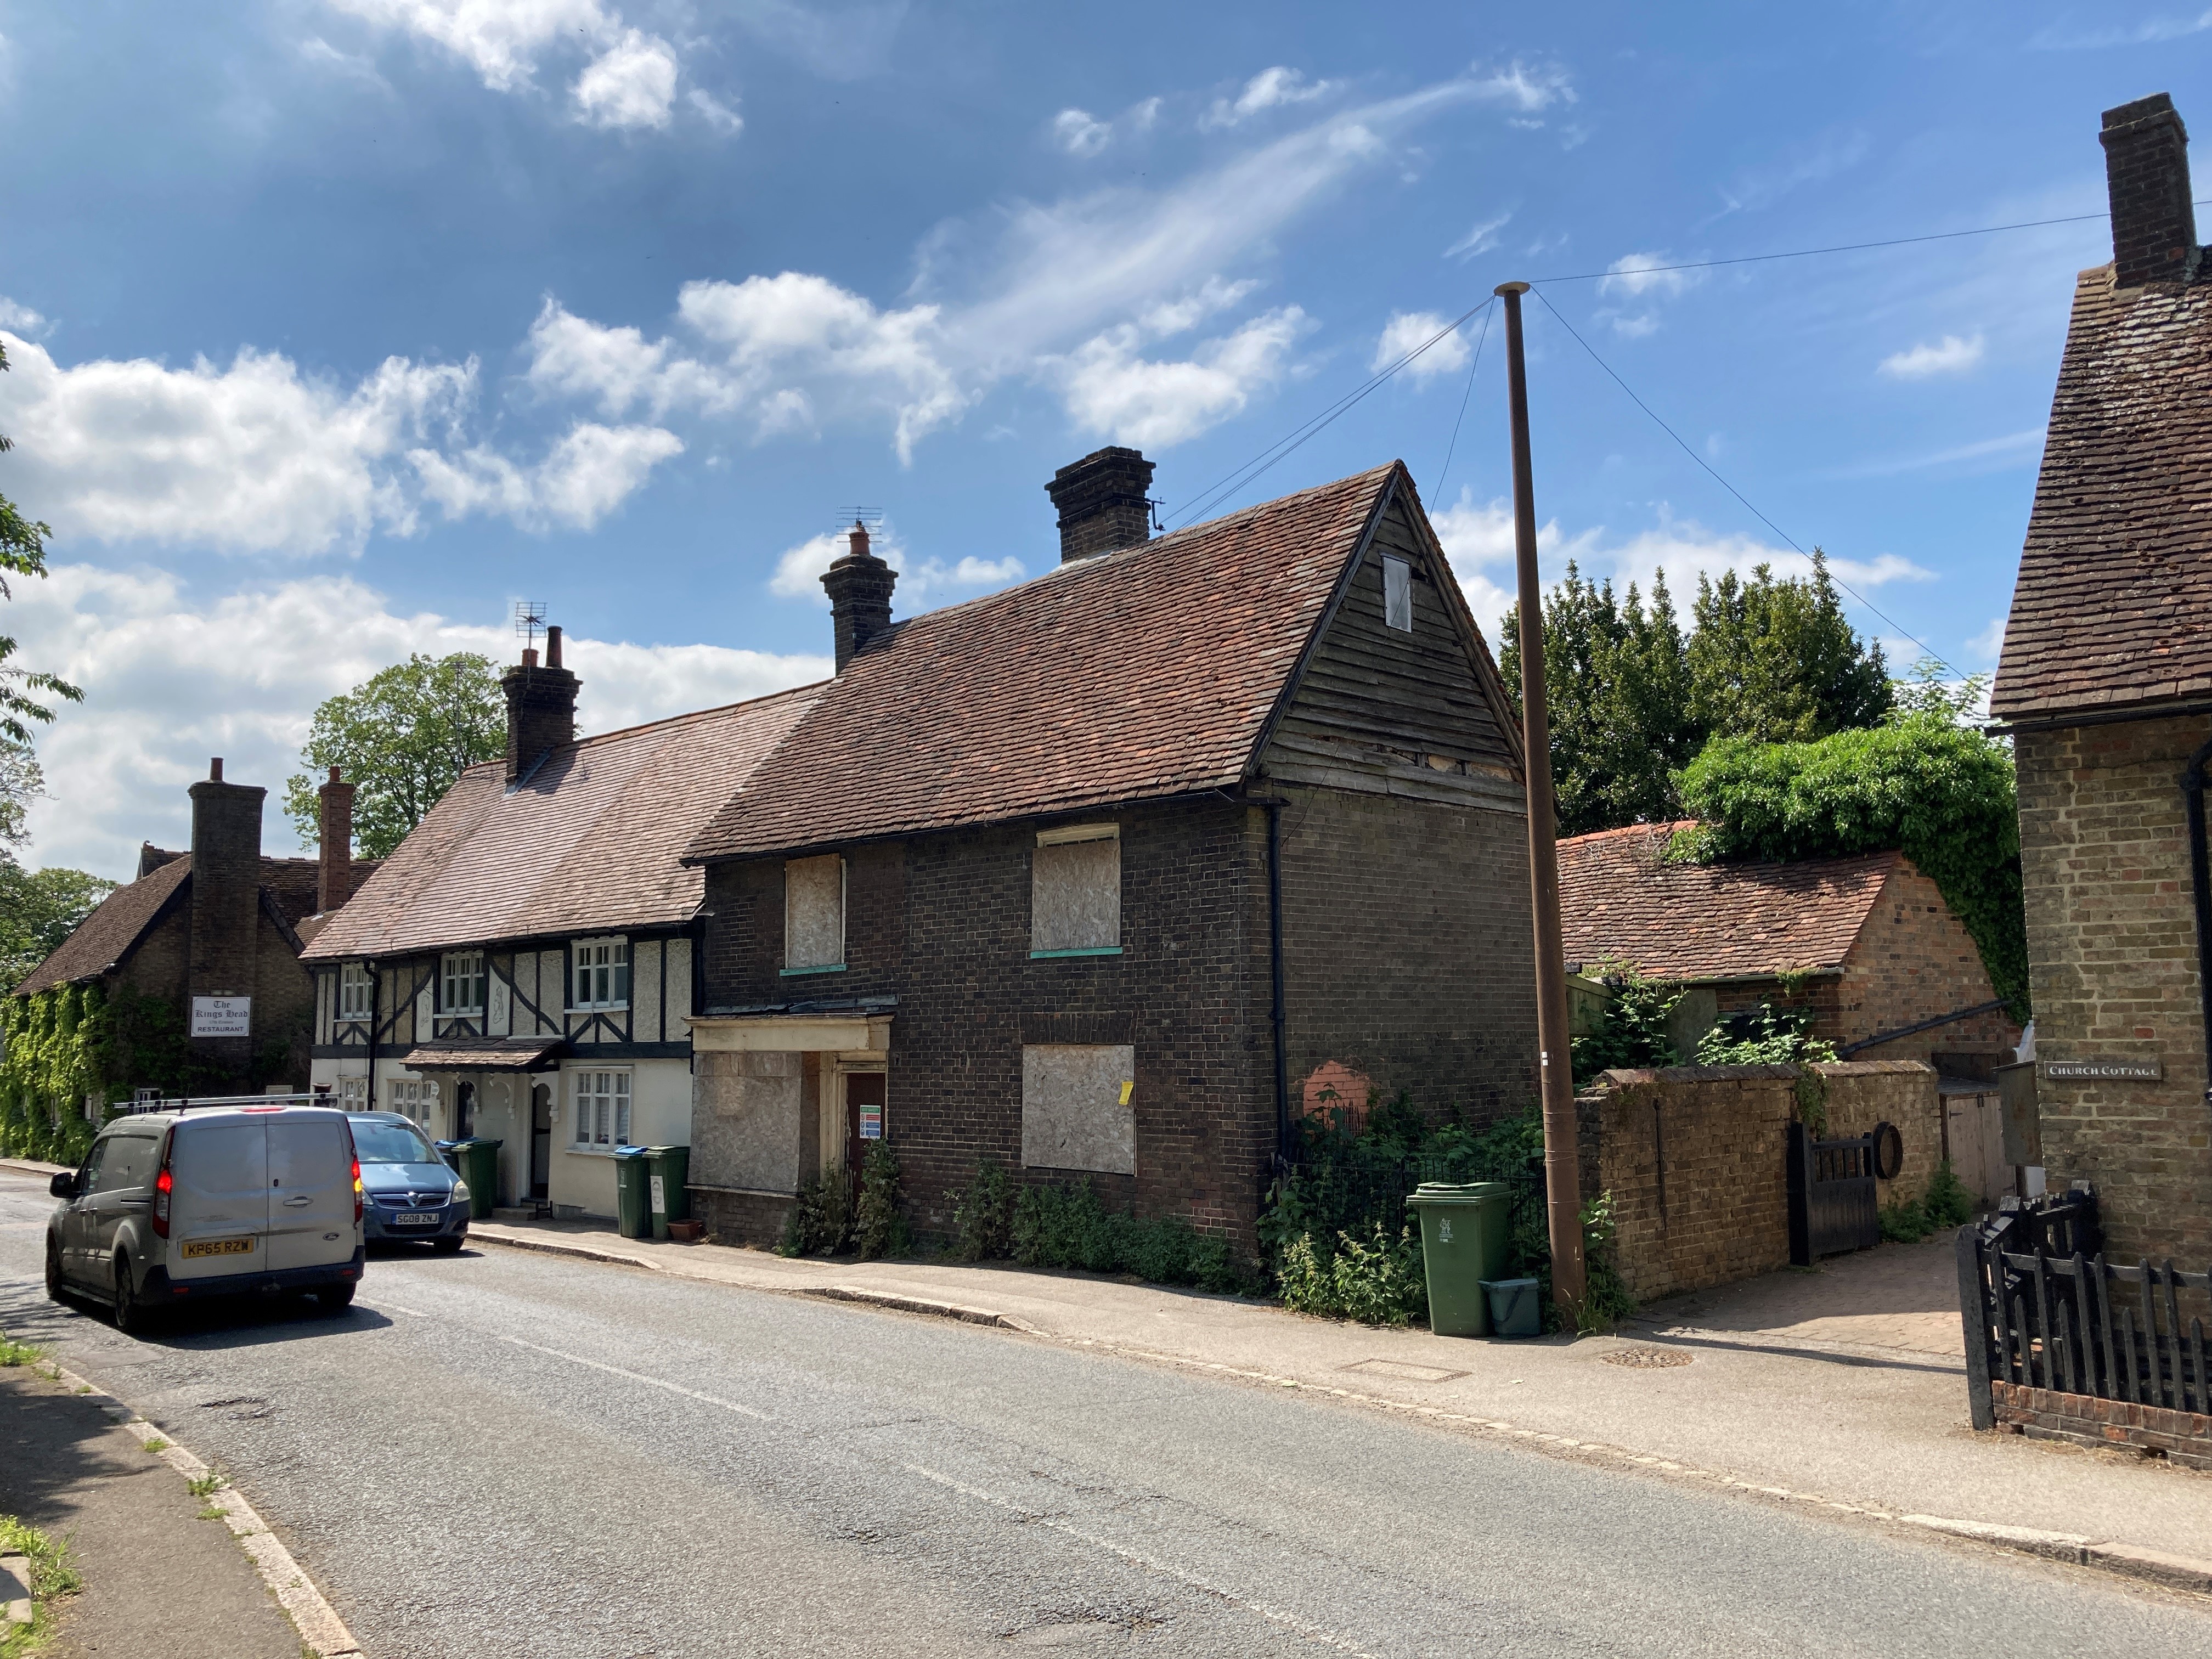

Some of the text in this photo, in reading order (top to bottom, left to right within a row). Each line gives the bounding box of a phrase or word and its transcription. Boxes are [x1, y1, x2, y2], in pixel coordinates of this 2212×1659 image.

[195, 1010, 247, 1019] Kings Head
[2049, 1066, 2098, 1075] CHURCH
[422, 1214, 437, 1222] ZNJ
[188, 1240, 249, 1255] KP65 RZW
